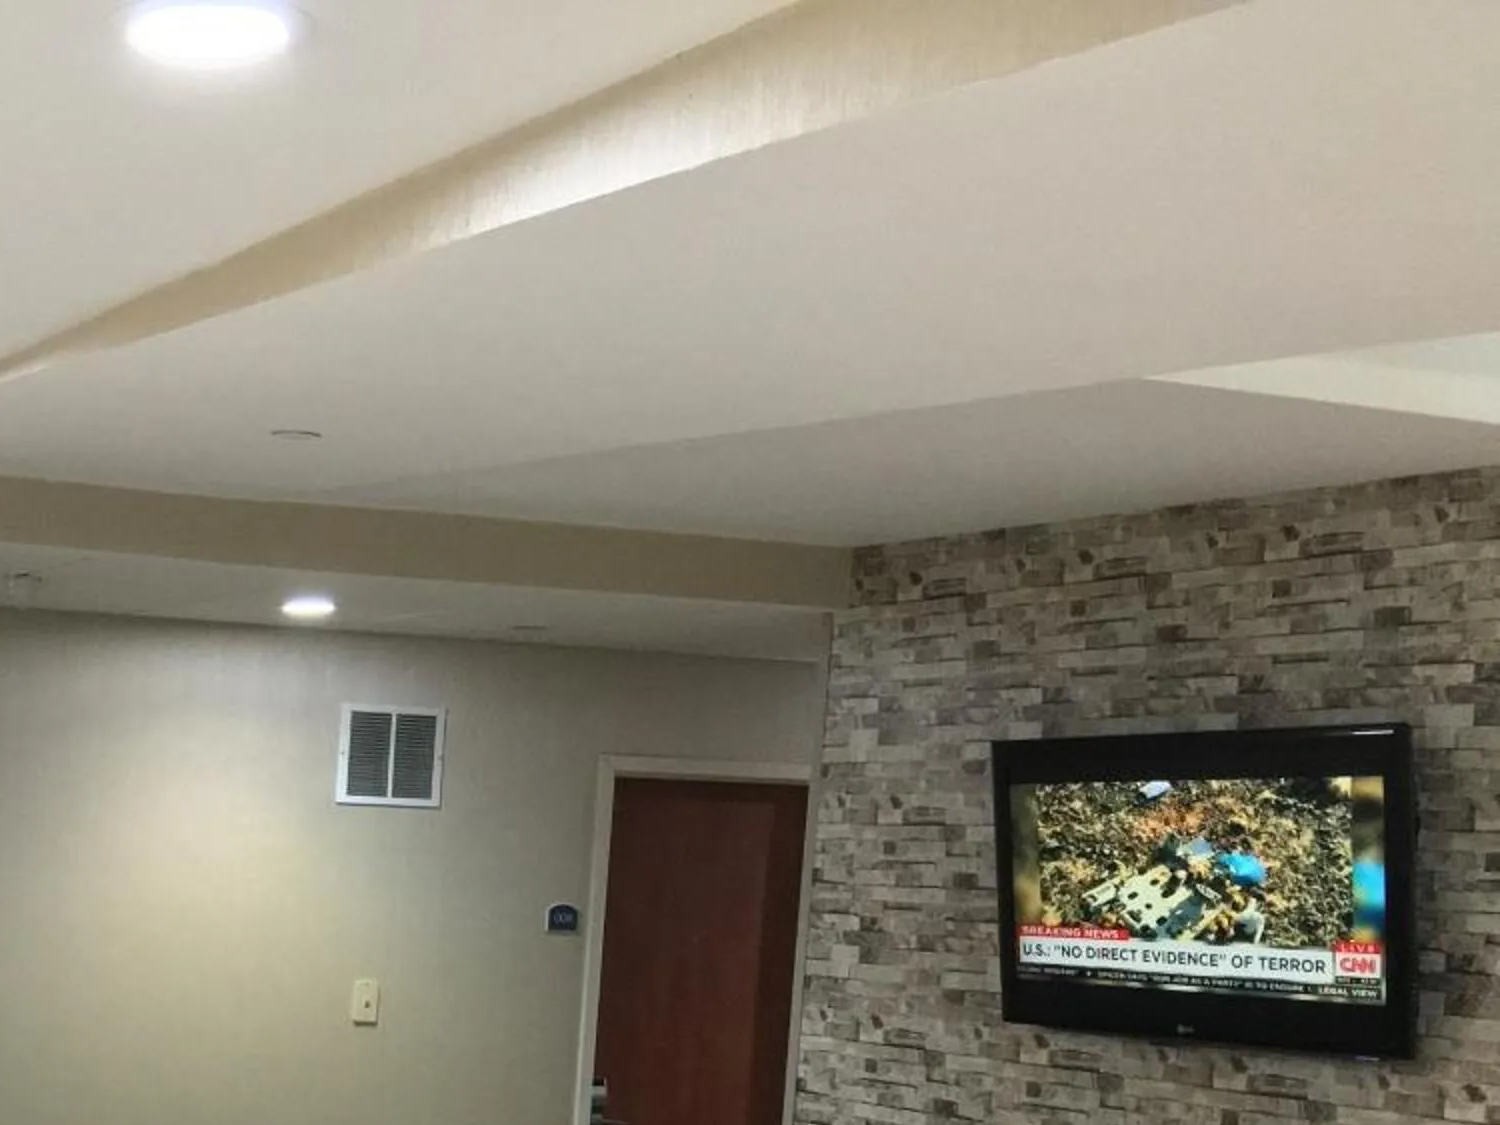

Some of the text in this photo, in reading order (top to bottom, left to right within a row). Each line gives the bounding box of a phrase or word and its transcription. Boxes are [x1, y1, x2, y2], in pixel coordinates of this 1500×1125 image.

[1085, 929, 1120, 939] NEWS
[1086, 947, 1137, 962] DIRECT
[1143, 949, 1227, 967] EVIDENCE"
[1231, 955, 1253, 969] OF
[1258, 956, 1327, 974] TERROR
[1339, 957, 1377, 974] CNN
